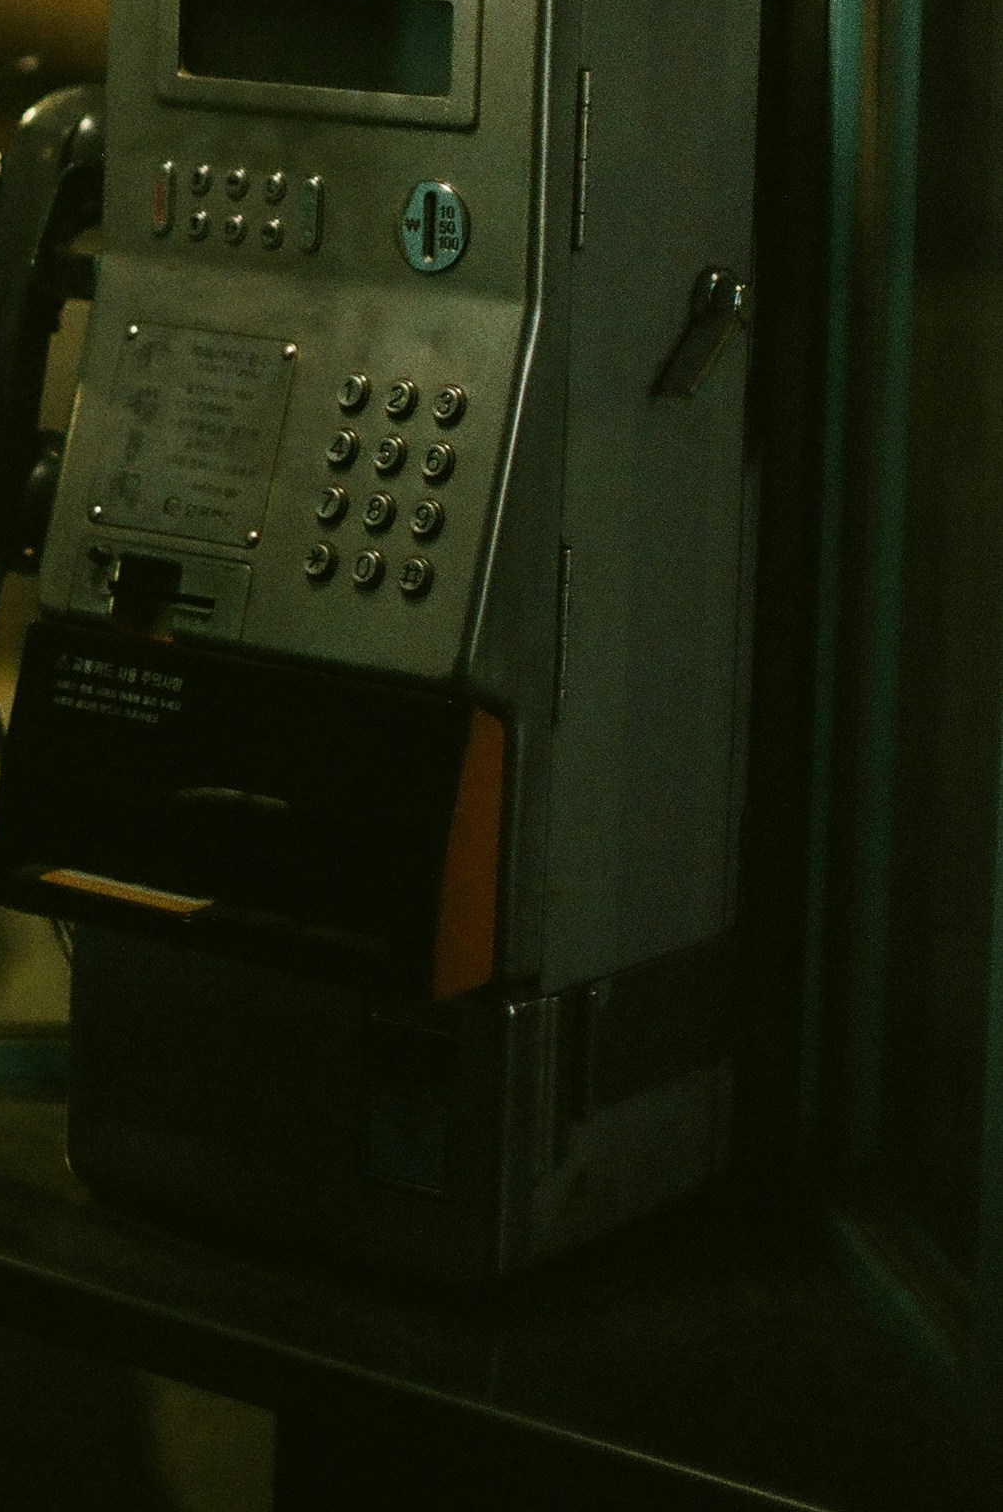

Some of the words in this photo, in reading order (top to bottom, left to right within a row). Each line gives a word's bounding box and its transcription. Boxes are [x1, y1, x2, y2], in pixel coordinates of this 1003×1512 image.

[440, 205, 455, 220] 10
[439, 220, 456, 235] 50
[439, 235, 460, 251] 100
